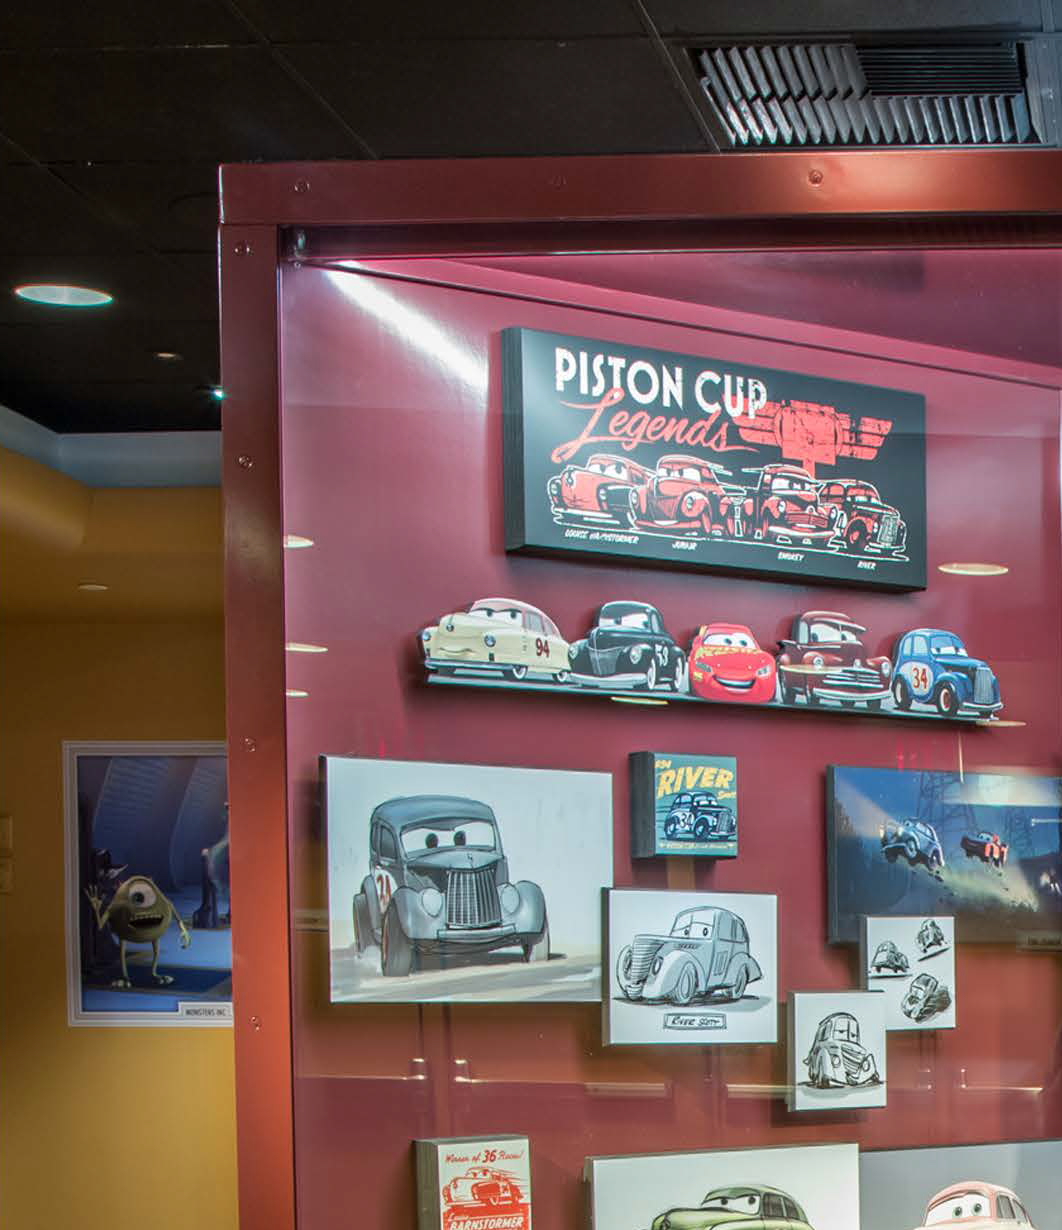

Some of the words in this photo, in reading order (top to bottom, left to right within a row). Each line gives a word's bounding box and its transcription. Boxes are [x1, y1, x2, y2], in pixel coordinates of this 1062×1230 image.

[555, 347, 684, 411] PISTON
[695, 371, 768, 419] CUP
[551, 388, 760, 463] Legends
[535, 637, 550, 658] 94
[912, 667, 928, 689] 34
[657, 766, 733, 800] RIVER
[481, 1149, 497, 1164] 36
